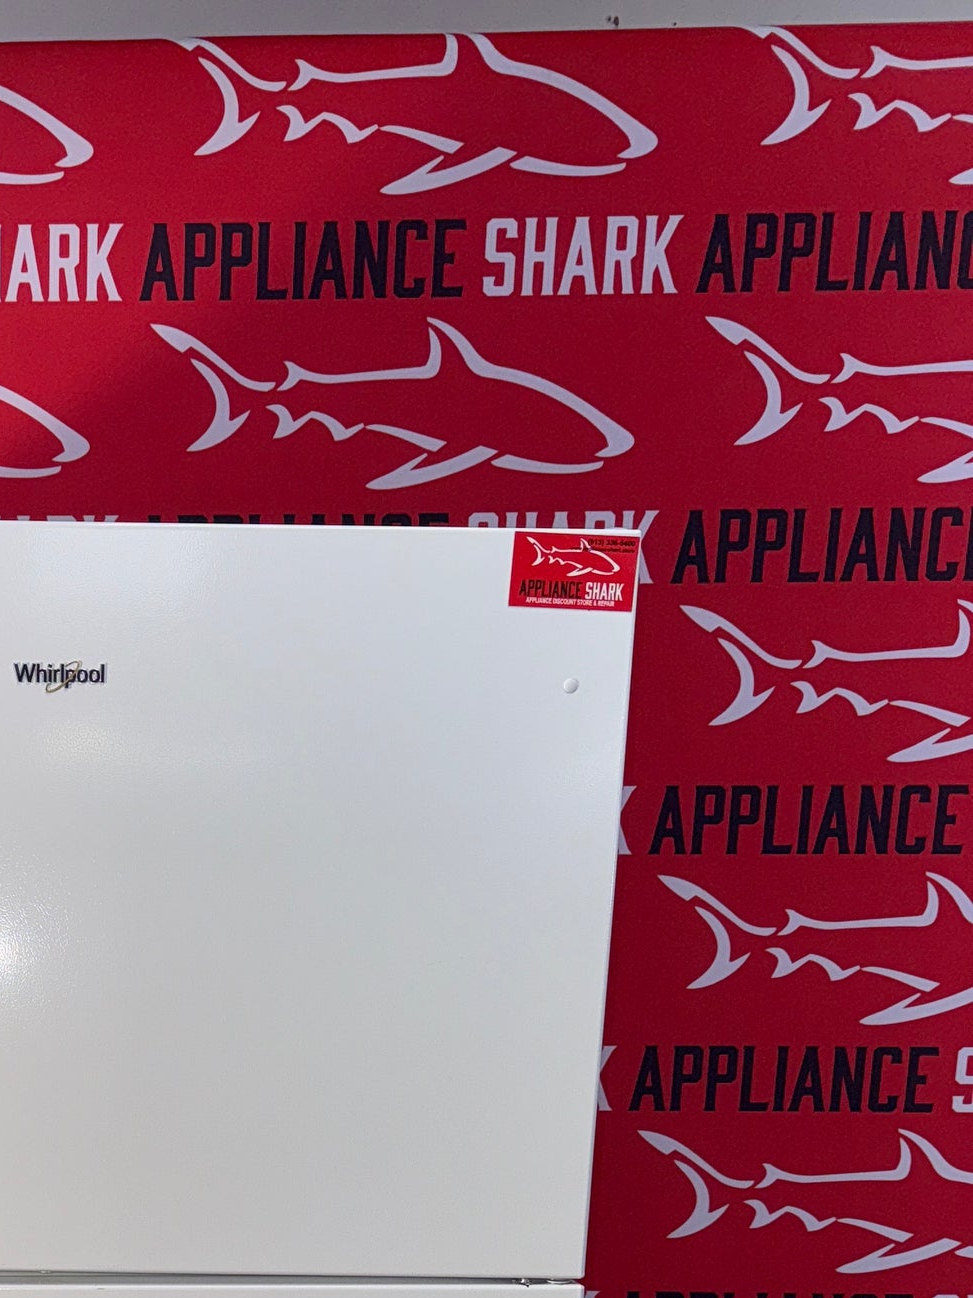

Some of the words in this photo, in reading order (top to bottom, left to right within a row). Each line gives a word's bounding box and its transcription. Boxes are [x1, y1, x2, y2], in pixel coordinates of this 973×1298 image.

[139, 218, 467, 301] APPLIANCE
[482, 214, 684, 296] SHARK
[670, 507, 973, 584] APPLIANC
[518, 579, 583, 599] APPLIANCE
[585, 581, 624, 601] SHARK
[526, 596, 552, 605] APPLIANCE
[552, 597, 577, 606] DISCOUNT
[577, 599, 593, 607] STORE
[13, 662, 106, 689] Whirlpool
[648, 784, 969, 855] APPLIANCE
[628, 1045, 939, 1112] APPLIANCE
